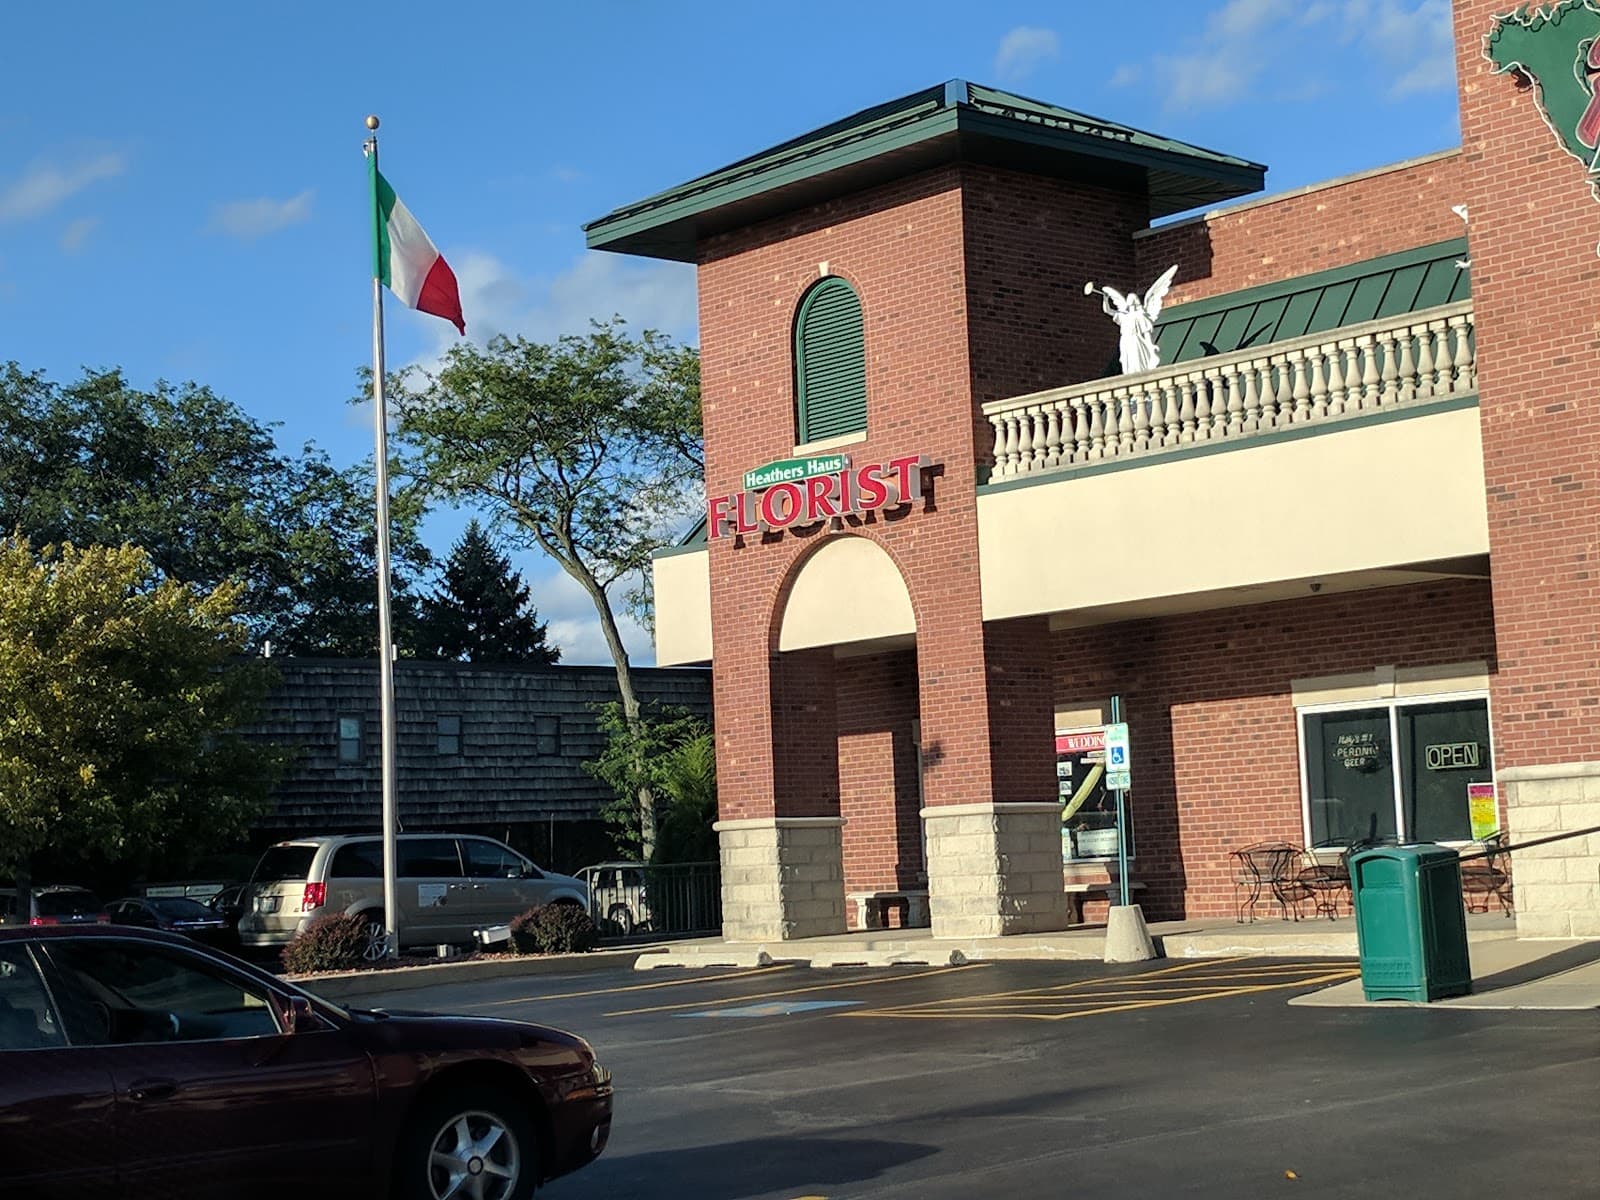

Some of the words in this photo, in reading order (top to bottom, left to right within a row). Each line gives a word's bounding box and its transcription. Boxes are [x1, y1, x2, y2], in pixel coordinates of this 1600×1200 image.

[746, 466, 804, 487] Heathers
[807, 458, 841, 475] Haus
[708, 455, 920, 539] FLORIST
[1428, 745, 1476, 767] OPEN
